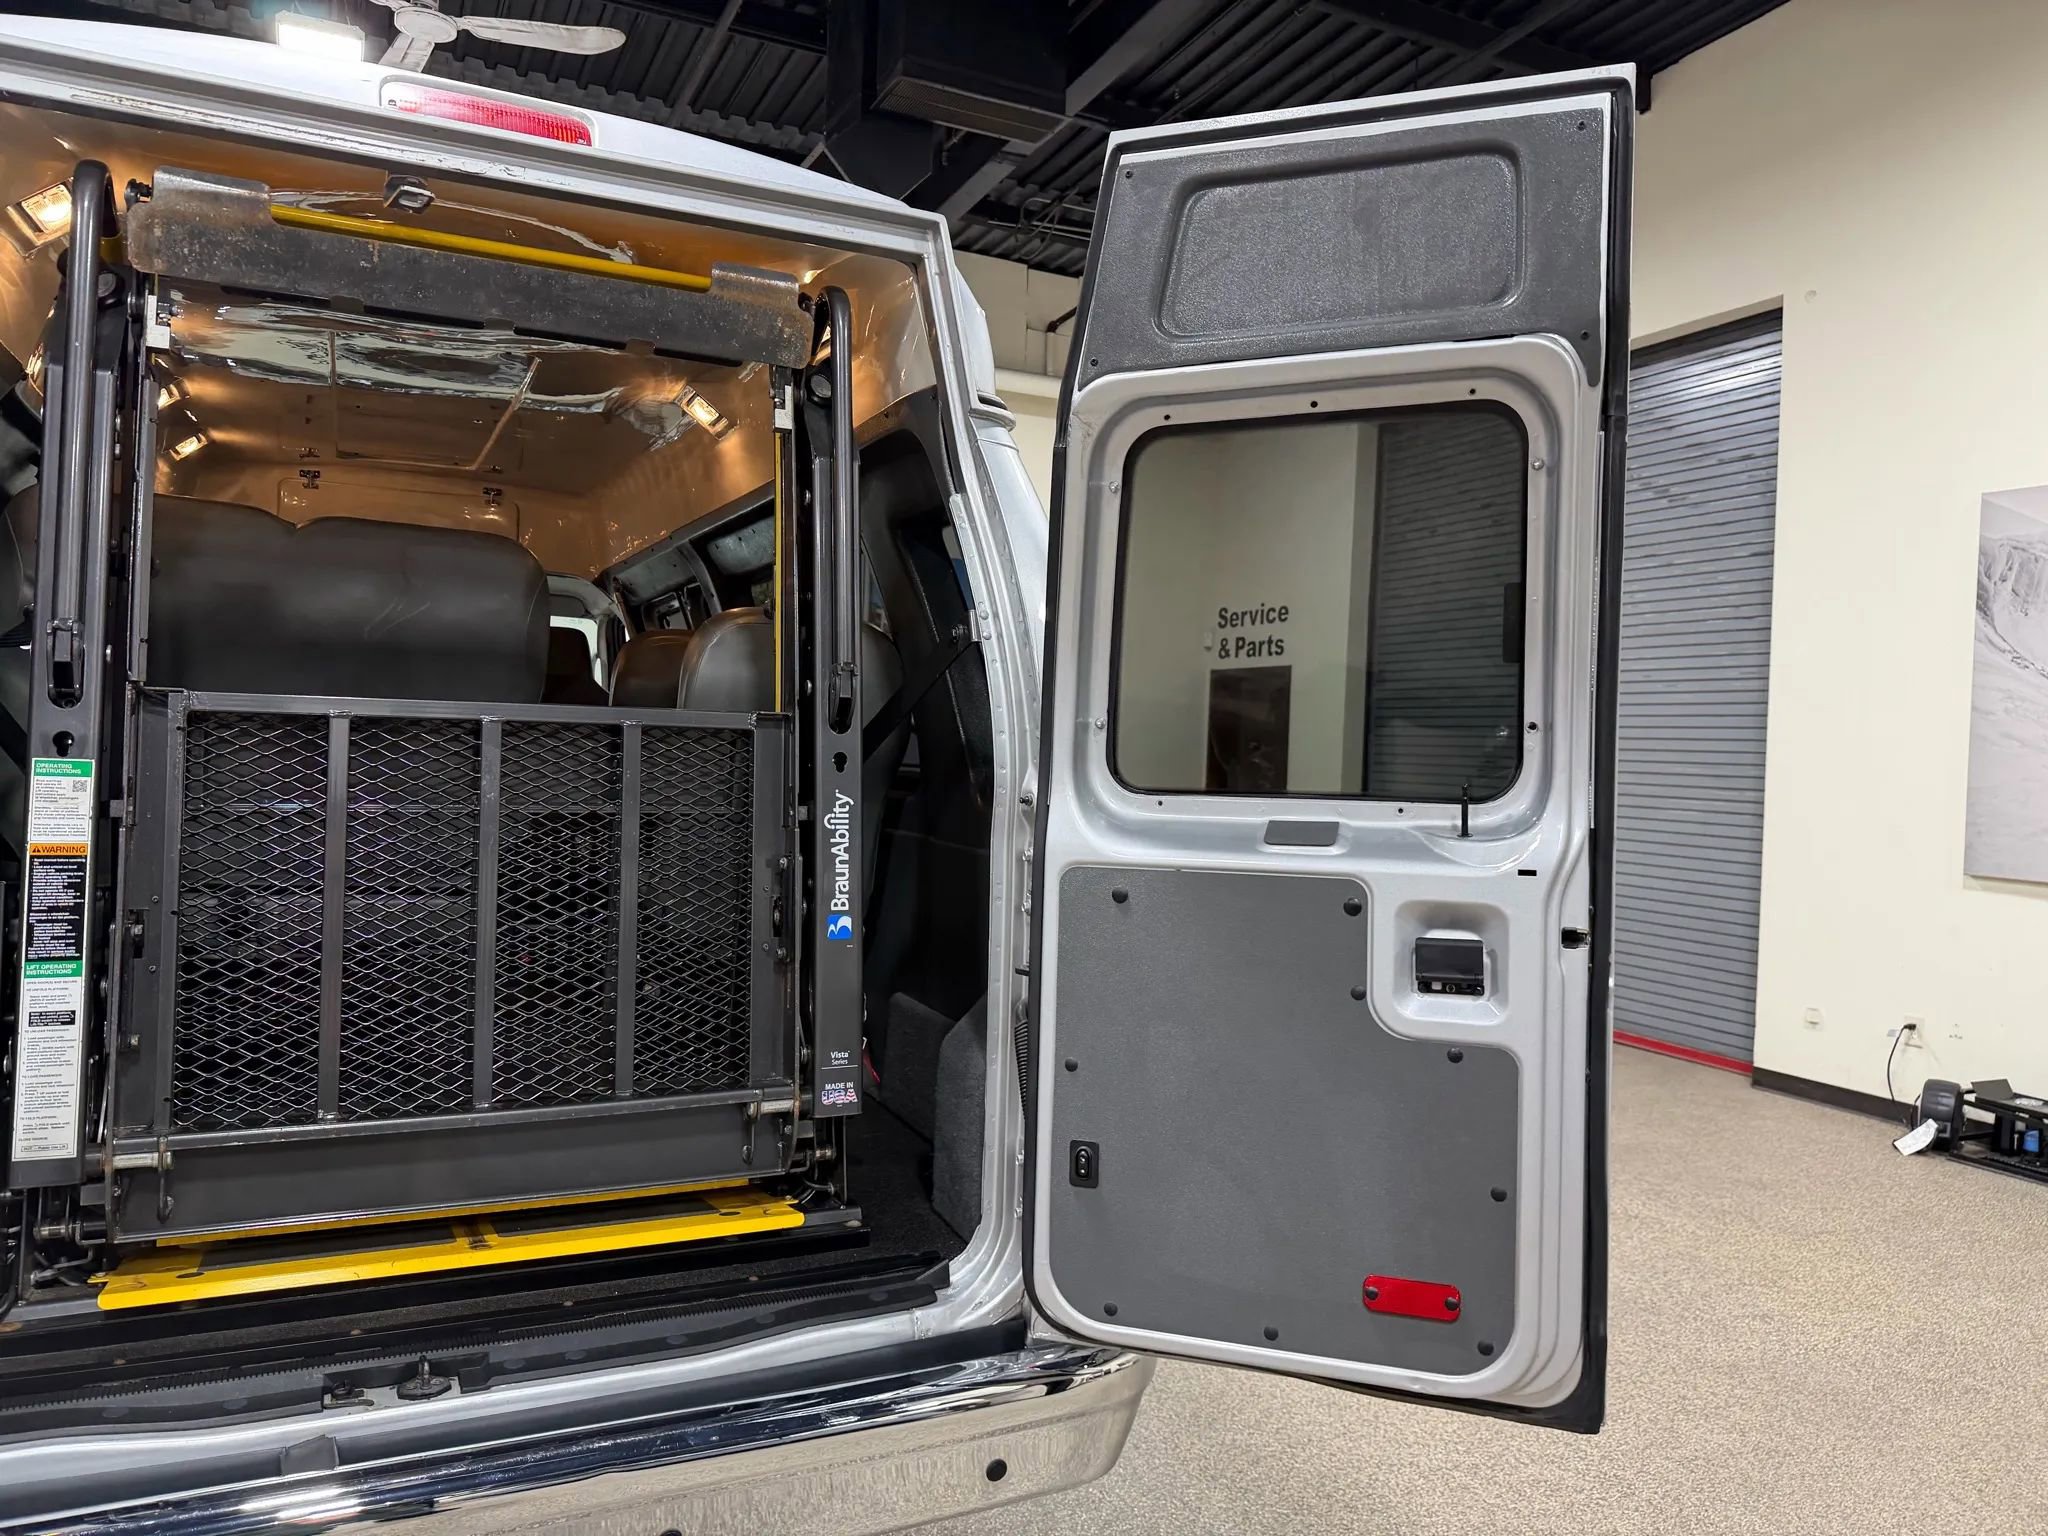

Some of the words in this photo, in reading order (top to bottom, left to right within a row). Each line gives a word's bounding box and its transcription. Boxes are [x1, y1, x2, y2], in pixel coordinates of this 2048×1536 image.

[1217, 602, 1289, 629] Service
[1218, 637, 1231, 660] &
[1234, 634, 1285, 658] Parts
[41, 845, 86, 854] WARNING
[823, 791, 855, 911] BraunAbility
[831, 1051, 849, 1059] Vista
[822, 1089, 858, 1105] USA
